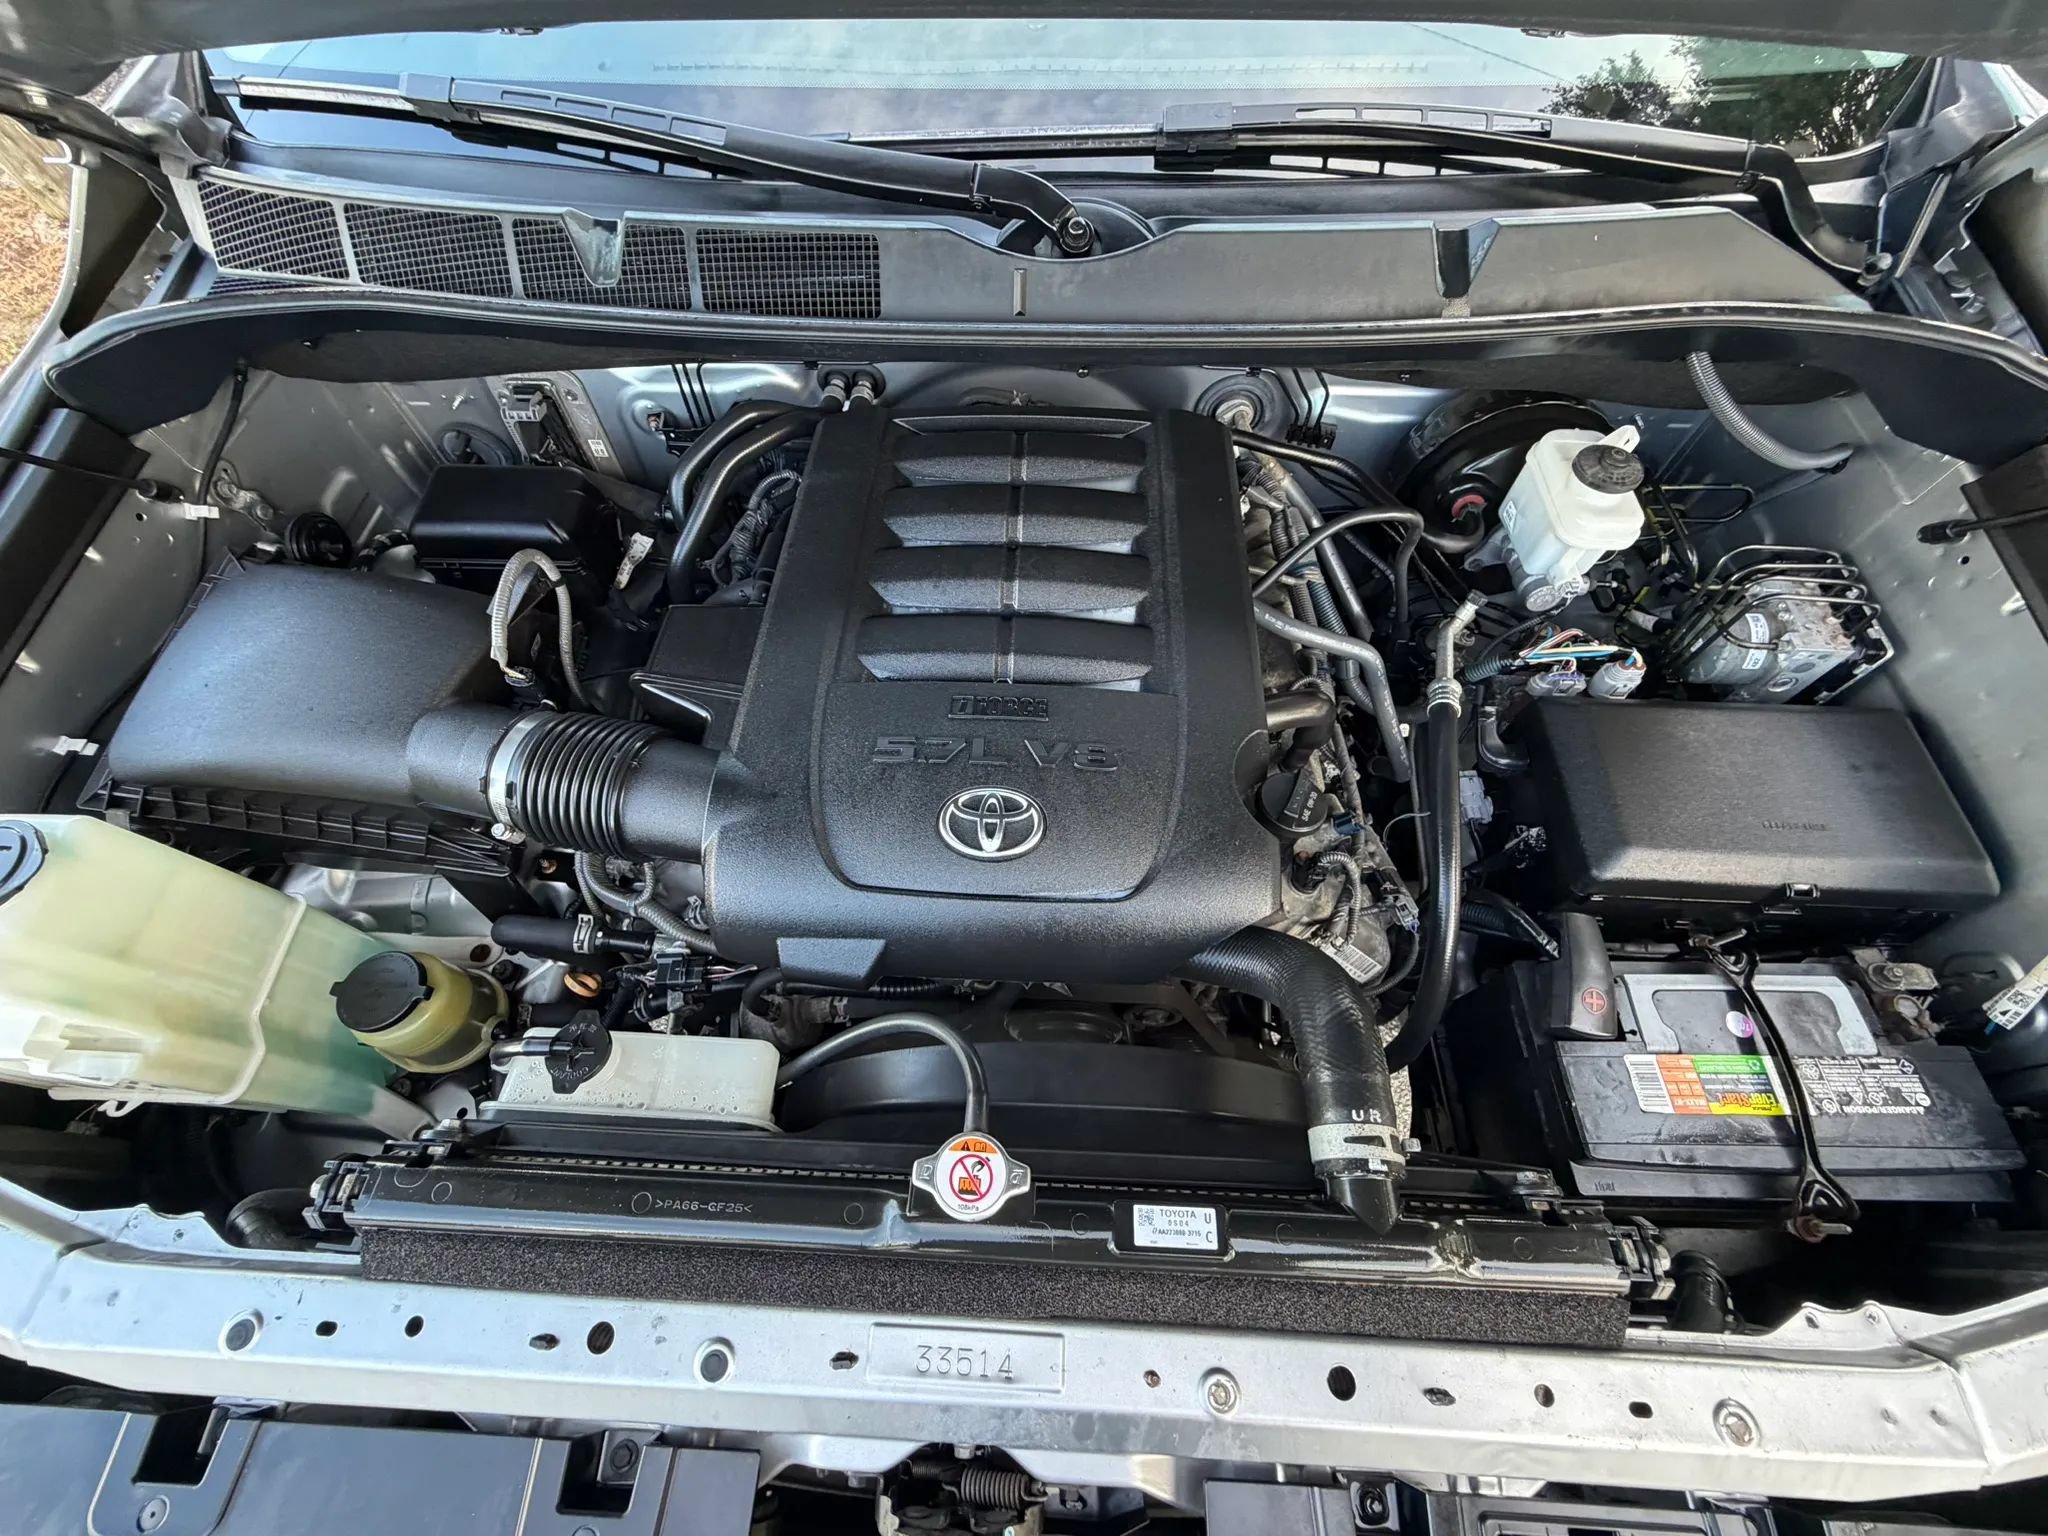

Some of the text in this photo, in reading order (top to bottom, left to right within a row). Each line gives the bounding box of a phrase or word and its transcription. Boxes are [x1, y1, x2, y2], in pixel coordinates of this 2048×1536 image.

[873, 736, 1118, 770] 5.7L V8
[1301, 808, 1312, 822] SAE
[1716, 1092, 1777, 1107] EverStart
[1842, 1105, 1919, 1114] DANGER/POISON
[1160, 1208, 1197, 1219] TOYOTA
[1204, 1212, 1212, 1225] U
[1205, 1231, 1213, 1244] C
[915, 1344, 1013, 1380] 33514
